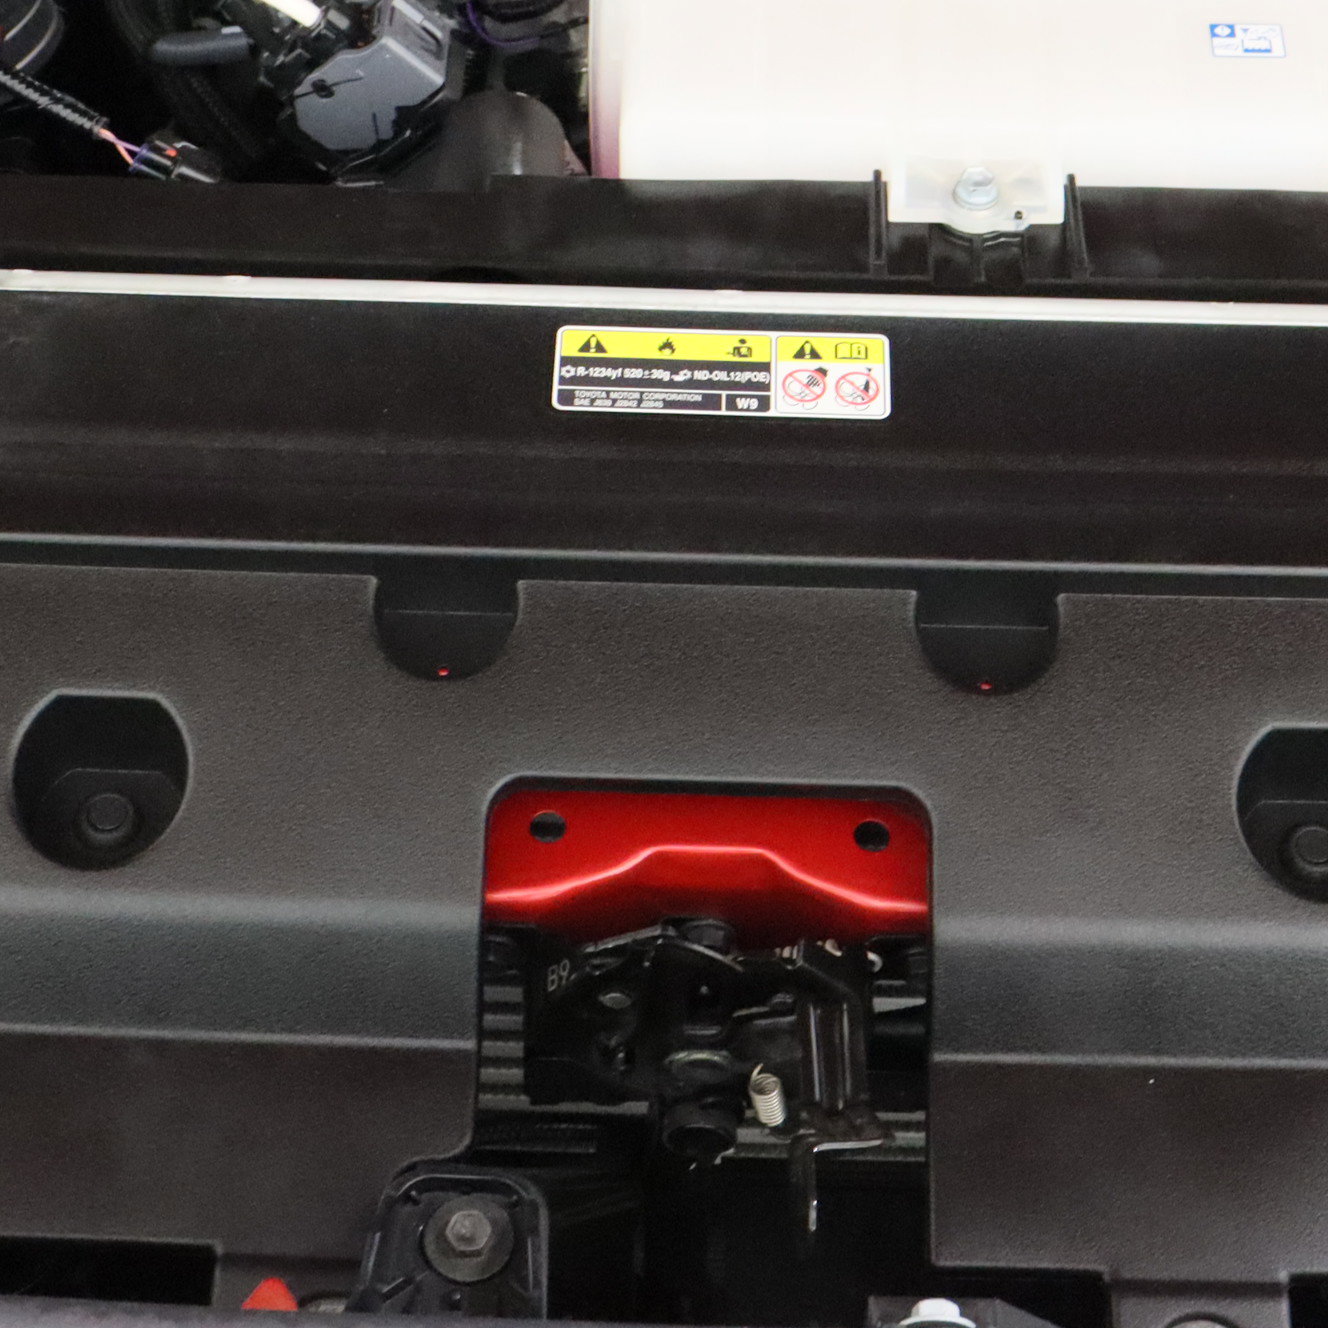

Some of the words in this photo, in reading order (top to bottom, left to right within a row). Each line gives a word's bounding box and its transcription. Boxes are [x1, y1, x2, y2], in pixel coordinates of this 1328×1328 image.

[576, 367, 622, 379] R-1234yf
[693, 370, 770, 384] ND-OIL12(POE)
[574, 390, 607, 399] TOYOTA
[609, 391, 641, 400] MOTOR
[642, 392, 702, 402] CORPORATION
[735, 397, 759, 410] W9
